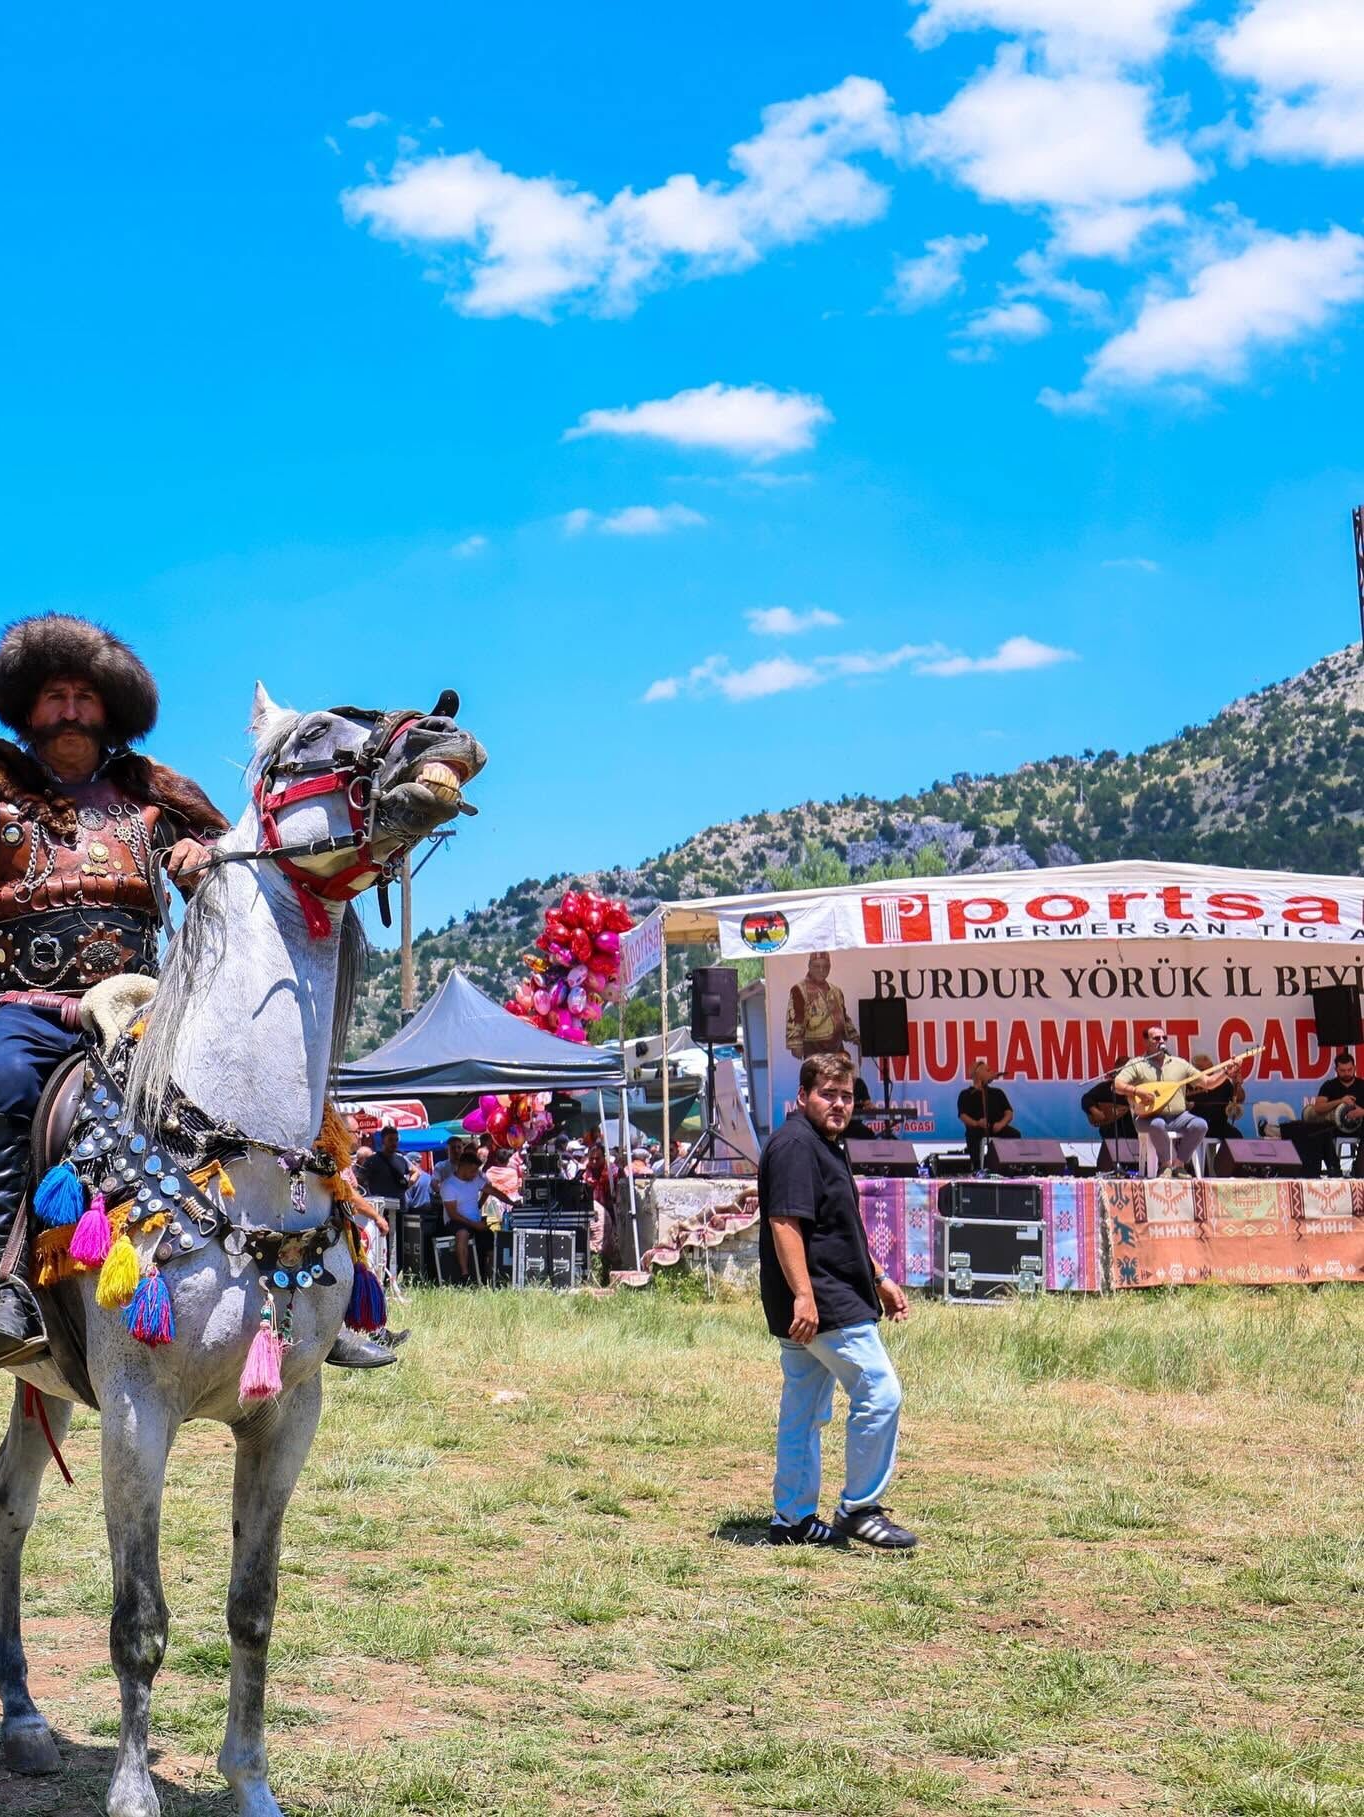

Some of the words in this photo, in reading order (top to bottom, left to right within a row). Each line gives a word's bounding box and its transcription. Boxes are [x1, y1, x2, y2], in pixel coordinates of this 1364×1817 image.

[946, 886, 1364, 940] portsa
[974, 922, 1143, 940] MERMER
[1153, 921, 1241, 936] SAN.
[1258, 922, 1334, 939] TİC.
[871, 967, 1052, 1000] BURDUR
[1060, 957, 1212, 999] YÖRÜK
[1222, 957, 1262, 998] İL
